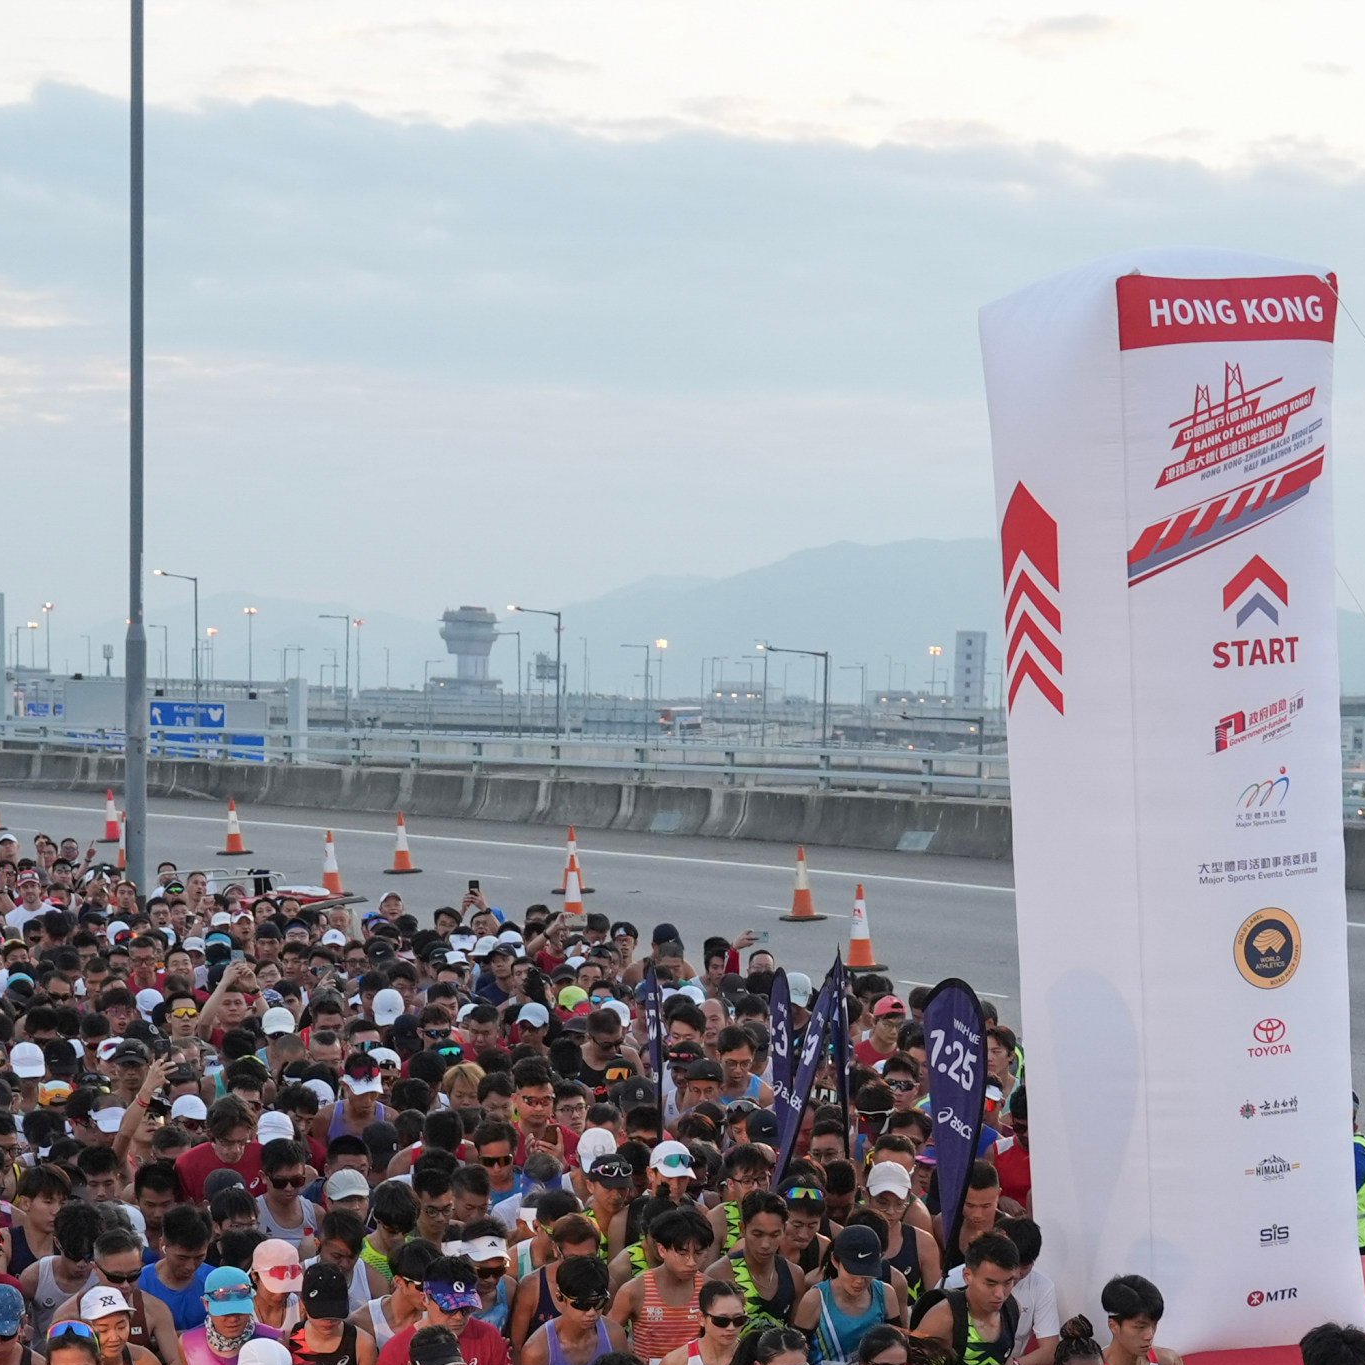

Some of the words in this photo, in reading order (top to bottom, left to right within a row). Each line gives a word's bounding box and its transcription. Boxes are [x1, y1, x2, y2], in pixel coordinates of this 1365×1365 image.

[1149, 297, 1237, 328] HONG
[1243, 295, 1324, 324] KONG
[1193, 433, 1222, 453] BANK
[1222, 429, 1235, 441] OF
[1235, 416, 1263, 436] CHINA
[1263, 406, 1289, 426] (HONG
[1289, 393, 1312, 413] KONG)
[1244, 462, 1259, 474] HALF
[1260, 448, 1292, 466] MARATHON
[1201, 464, 1221, 481] HONG
[1212, 636, 1299, 669] START
[1229, 716, 1288, 747] Government-funded
[1199, 875, 1225, 886] Major
[1227, 873, 1256, 884] Sports
[1258, 871, 1283, 881] Events
[1255, 961, 1285, 970] ATHLETICS
[1260, 955, 1280, 963] WORLD
[930, 1029, 977, 1092] 1:25
[1248, 1044, 1291, 1058] TOYOTA
[950, 1114, 973, 1140] asics
[1256, 1162, 1291, 1176] HIMALAYA
[1265, 1287, 1298, 1302] MTR
